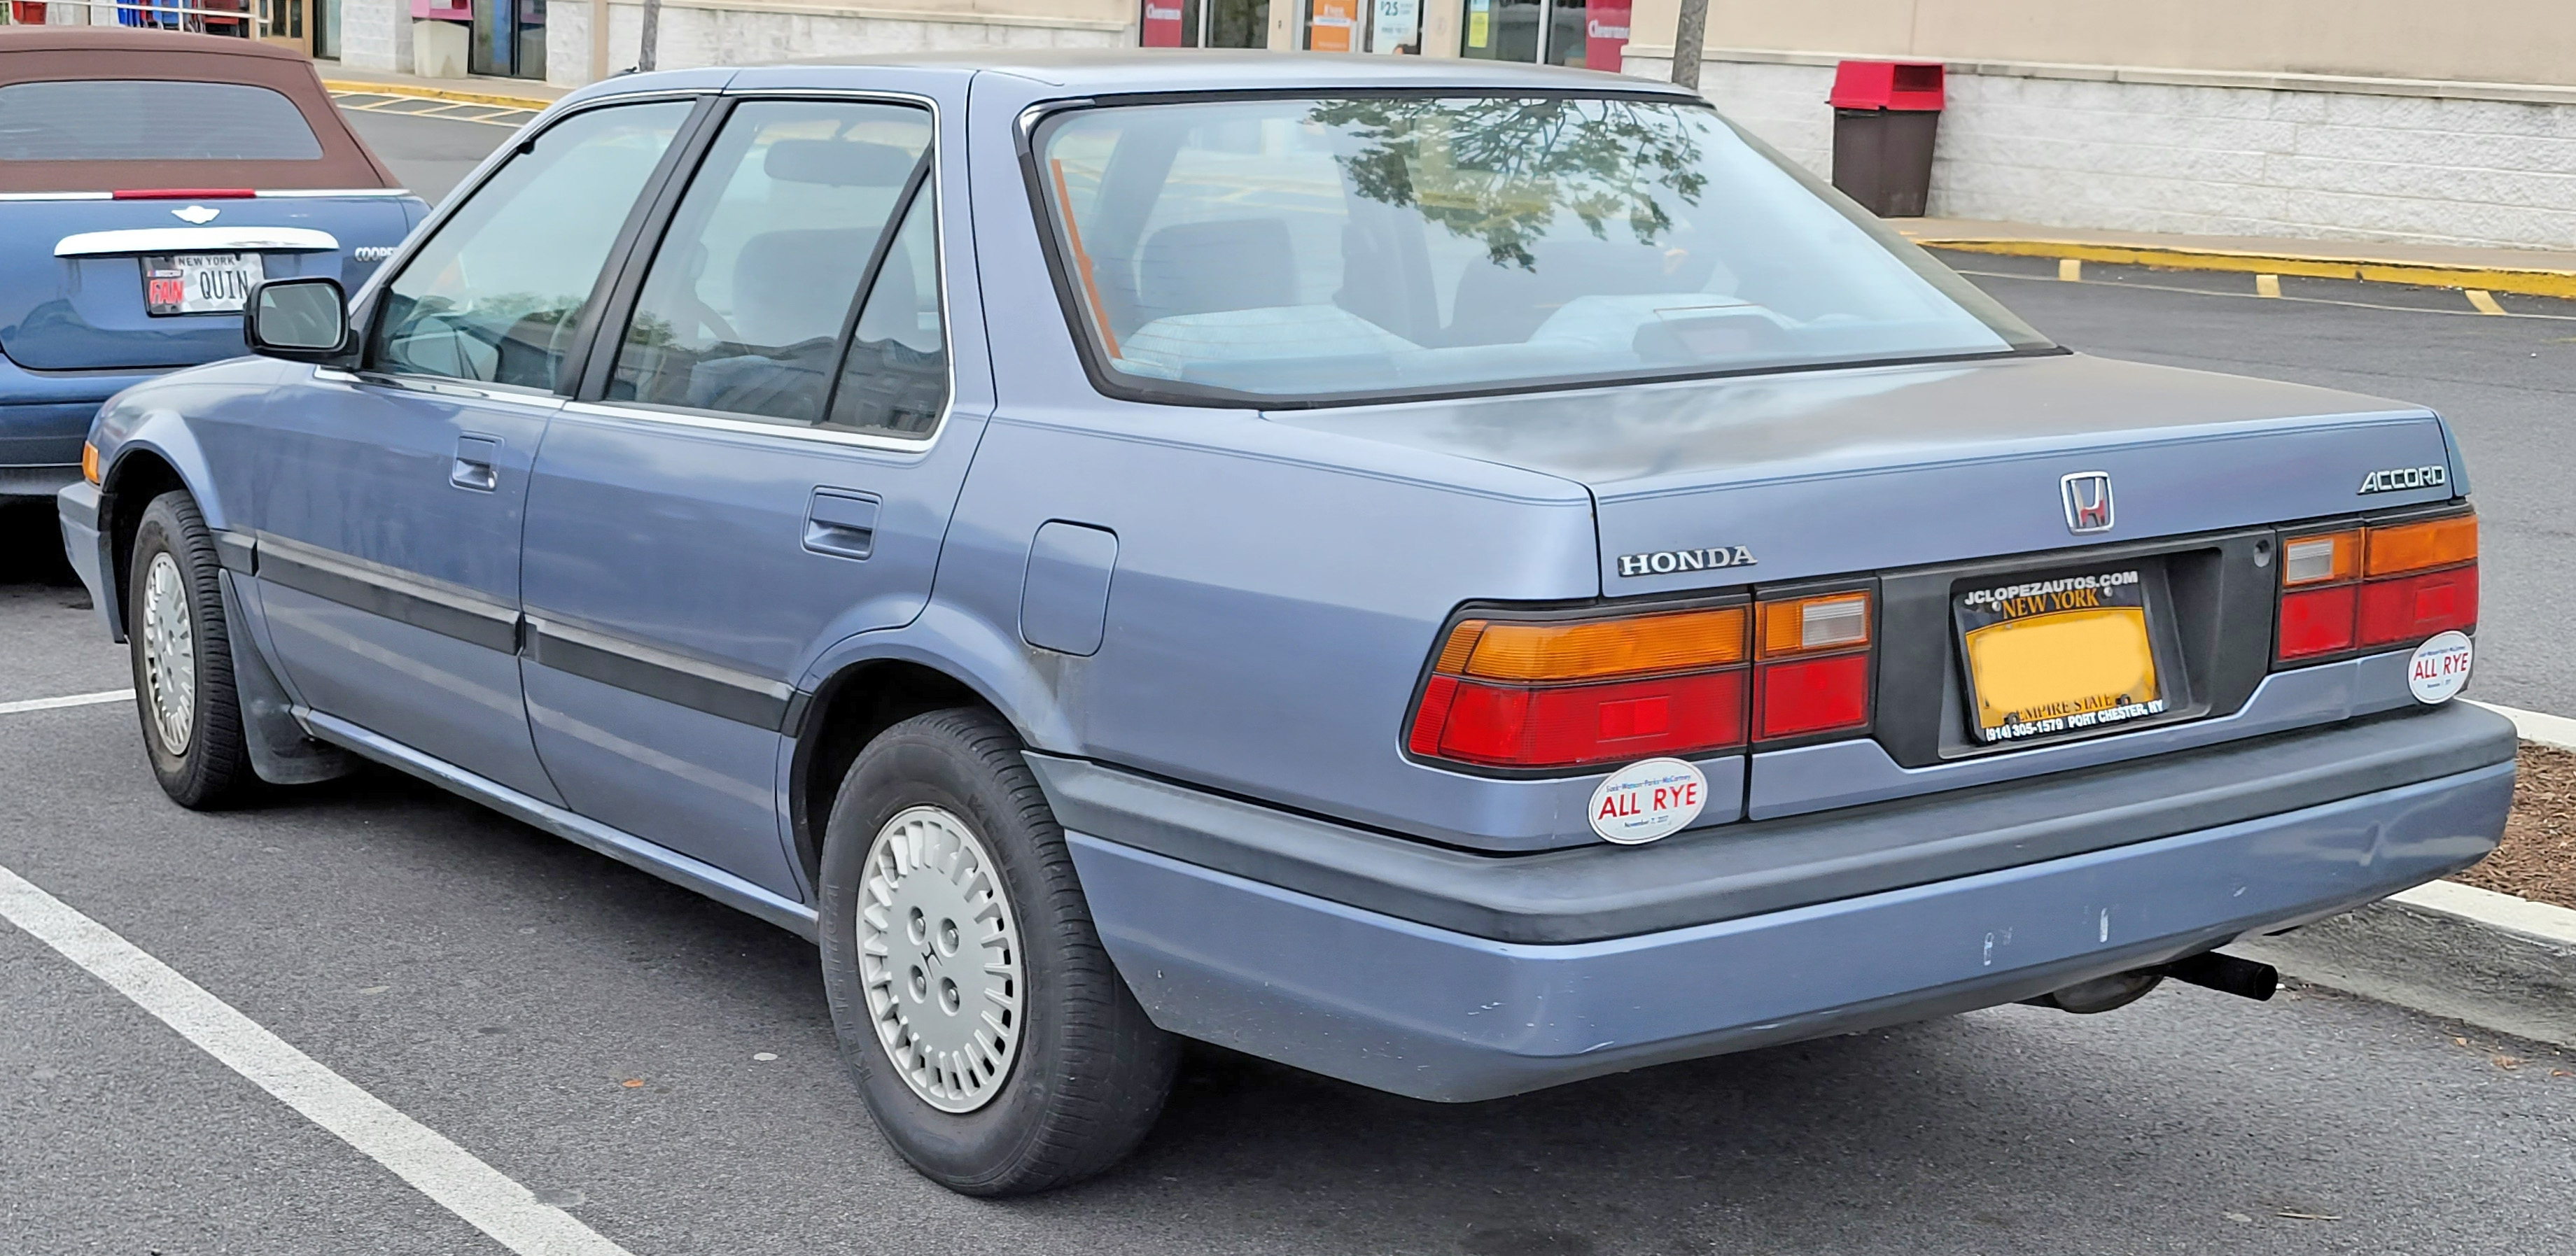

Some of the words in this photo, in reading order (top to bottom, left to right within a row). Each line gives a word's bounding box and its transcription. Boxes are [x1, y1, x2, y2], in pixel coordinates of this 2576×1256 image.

[178, 257, 203, 266] NEW
[206, 256, 236, 266] YORK
[148, 278, 184, 304] FAN
[2357, 465, 2446, 494] ACCORD
[1620, 545, 1758, 576] HONDA
[1963, 570, 2139, 605] JCLOPEZAUTOS.COM
[2001, 594, 2047, 619] NEW
[2050, 588, 2100, 610] YORK
[2413, 658, 2437, 682] ALL
[2442, 651, 2469, 676] RYE
[1985, 723, 2012, 742] (914)
[2012, 718, 2064, 738] 305-1579
[2067, 711, 2096, 728] PORT
[2148, 699, 2164, 714] NY
[1597, 792, 1642, 821] ALL
[1653, 782, 1698, 812] RYE
